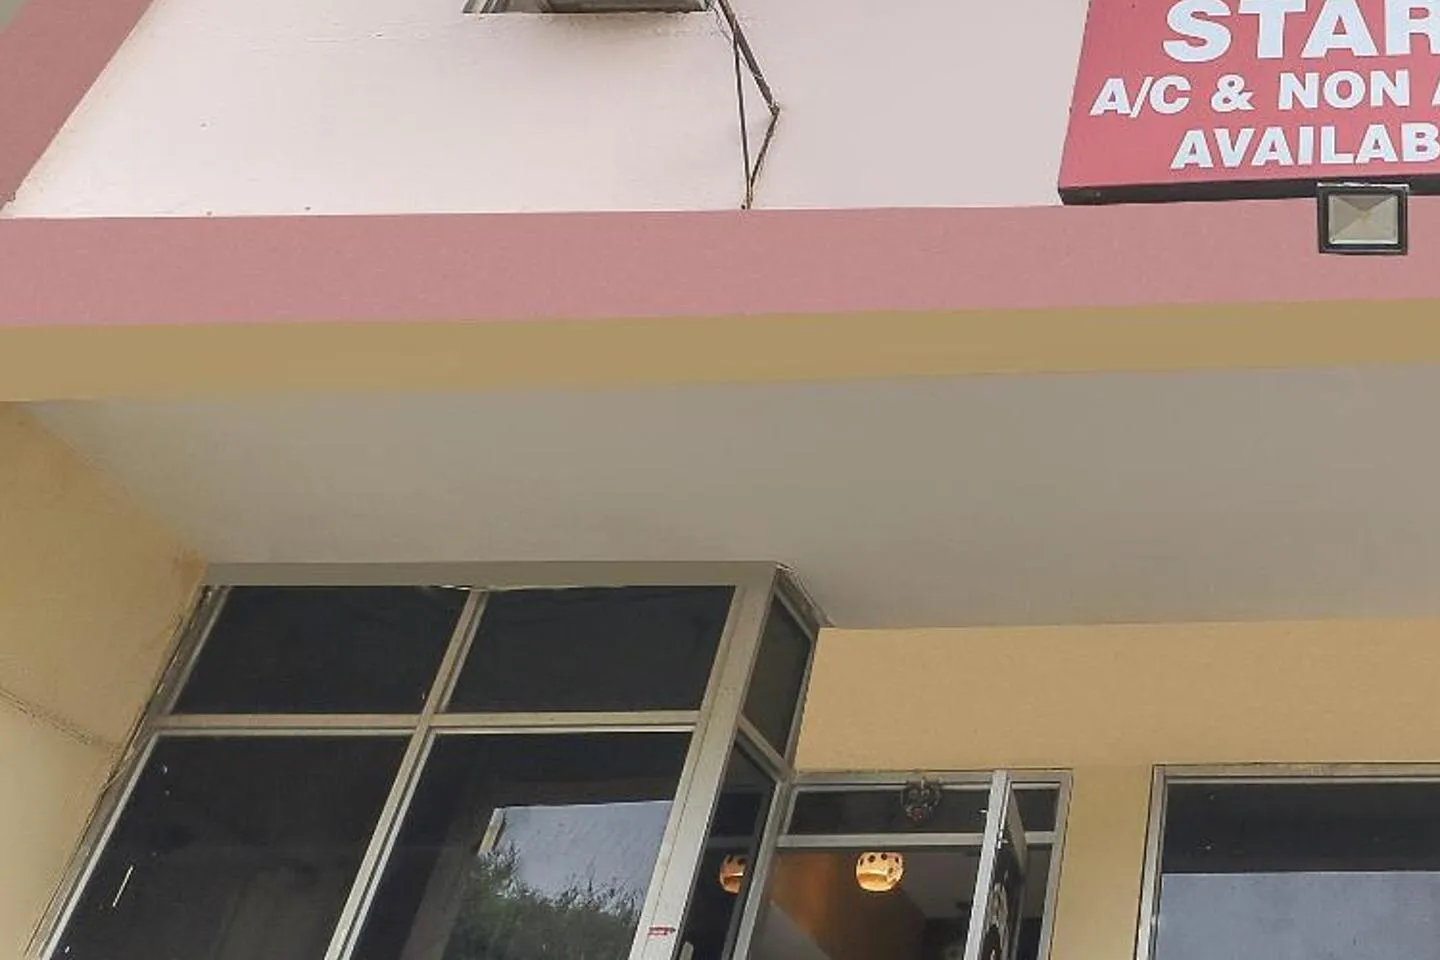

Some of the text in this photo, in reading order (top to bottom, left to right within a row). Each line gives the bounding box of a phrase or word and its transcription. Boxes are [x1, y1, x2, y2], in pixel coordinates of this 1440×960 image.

[1089, 76, 1191, 119] A/C
[1211, 74, 1255, 112] &
[1278, 69, 1411, 110] NON
